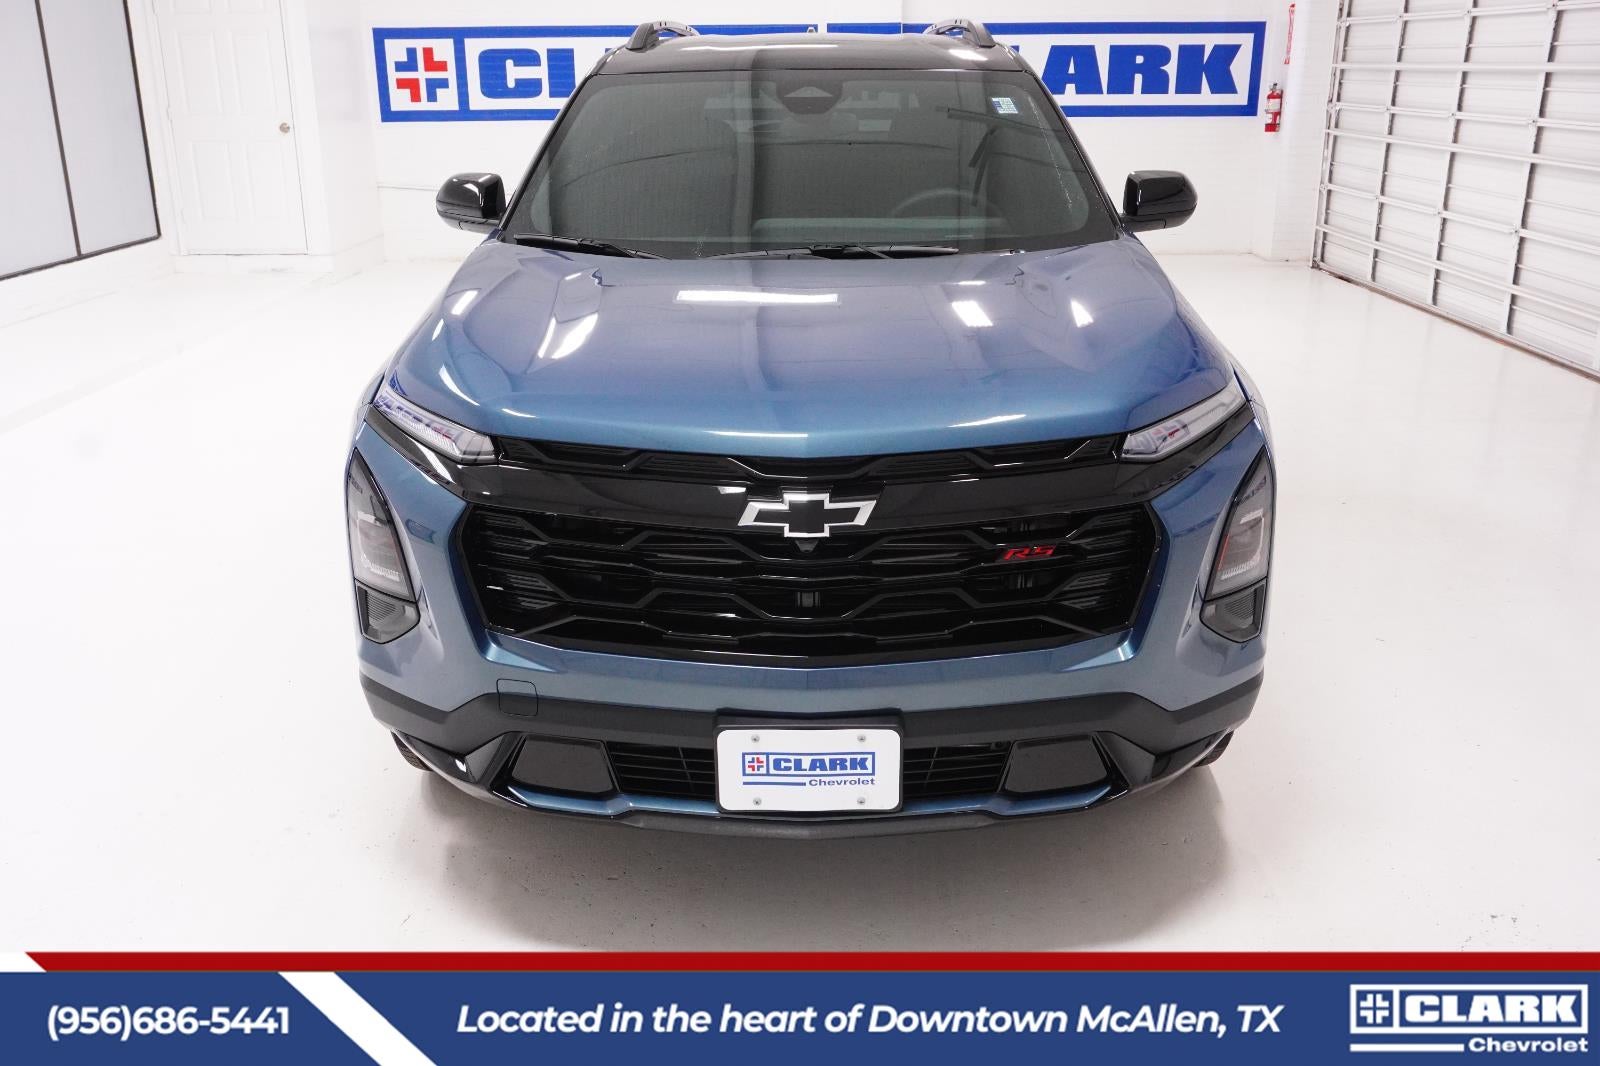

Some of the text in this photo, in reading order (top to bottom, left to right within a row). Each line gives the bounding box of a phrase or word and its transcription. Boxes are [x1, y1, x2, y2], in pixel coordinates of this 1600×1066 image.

[1003, 545, 1056, 561] RS
[772, 757, 869, 772] CLARK
[808, 777, 876, 787] Chevrolet
